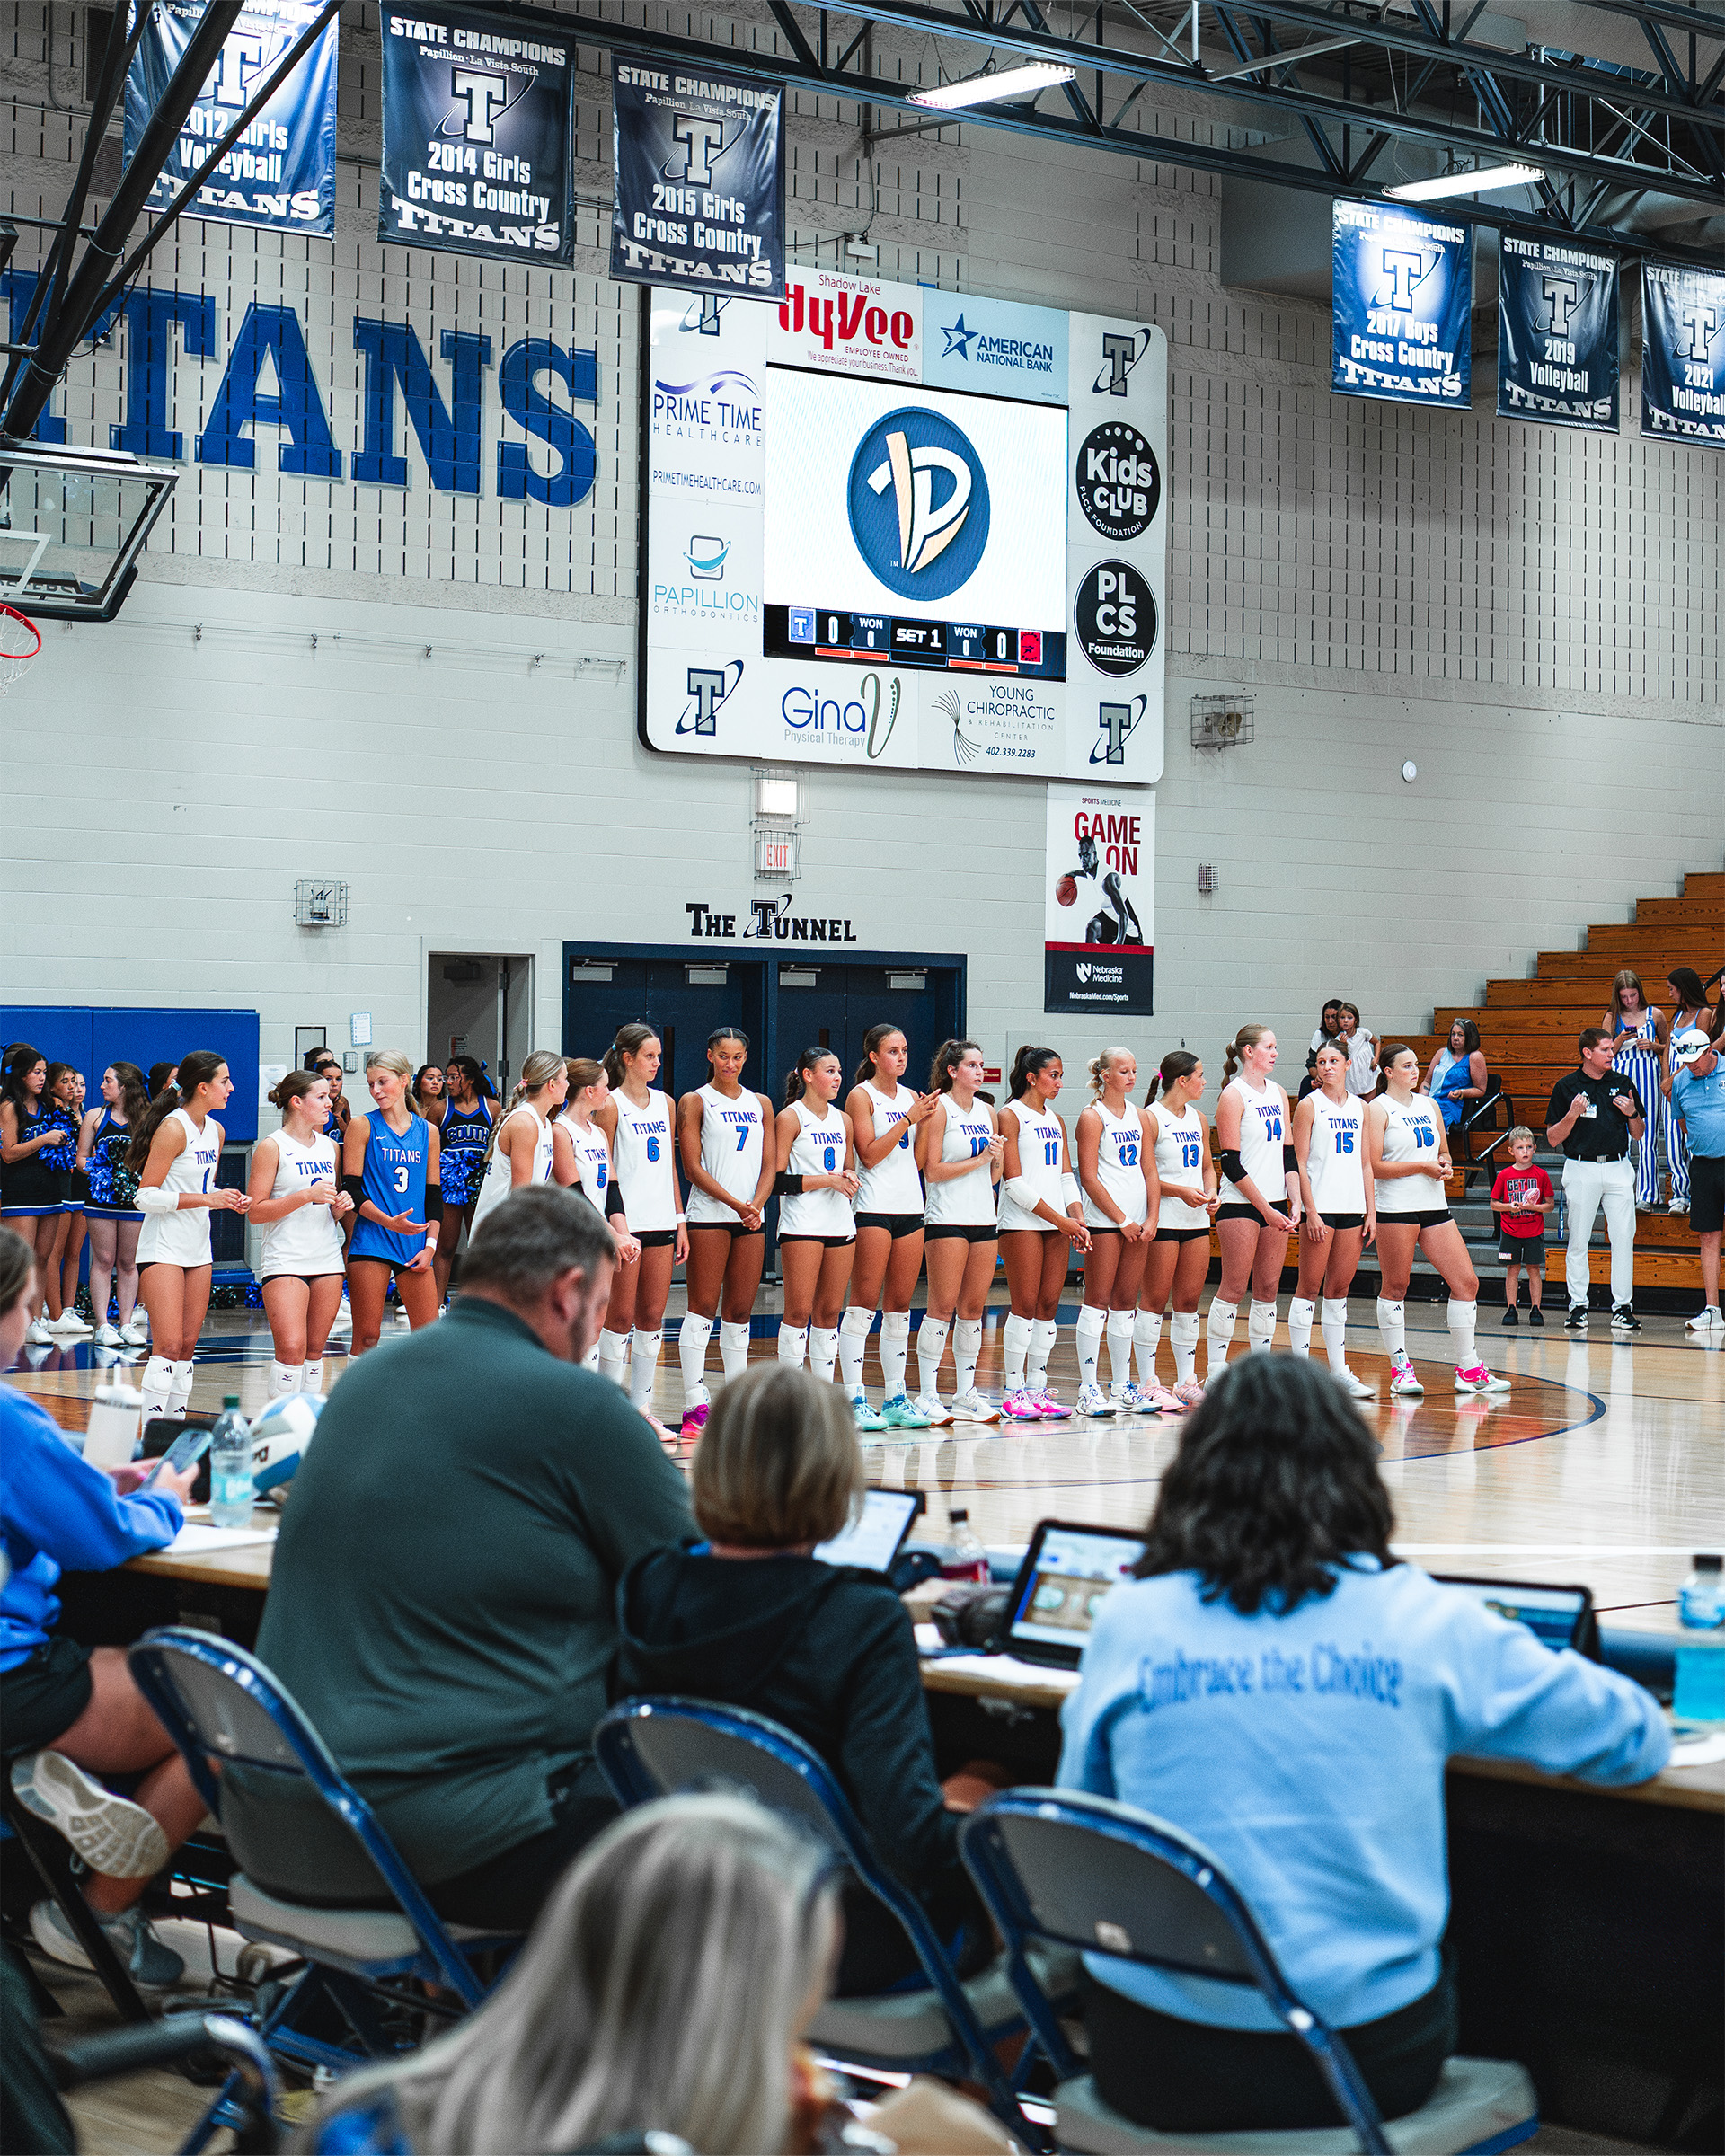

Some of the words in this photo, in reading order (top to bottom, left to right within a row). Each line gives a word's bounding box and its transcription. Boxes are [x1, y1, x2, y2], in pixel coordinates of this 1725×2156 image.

[390, 16, 447, 44] STATE
[453, 29, 566, 66] CHAMPIONS
[419, 45, 465, 64] Papillion
[469, 55, 483, 66] La
[484, 57, 510, 71] Vista
[510, 63, 540, 77] South
[618, 65, 669, 91] STATE
[675, 75, 778, 110] CHAMPIONS
[451, 65, 509, 148] T
[645, 93, 686, 110] Papillion
[688, 101, 702, 112] La
[703, 102, 724, 117] Vista
[724, 109, 753, 122] South
[180, 137, 282, 183] Voleyball
[427, 141, 478, 176] 2014
[483, 151, 531, 184] Girls
[673, 111, 724, 190] T
[407, 170, 467, 207] Cross
[473, 181, 550, 224] Country
[652, 183, 696, 216] 2015
[702, 191, 746, 225] Girls
[391, 194, 561, 252] TITANS
[1339, 210, 1380, 229] STATE
[1383, 216, 1464, 244] CHAMPIONS
[633, 212, 687, 246] Cross
[694, 221, 762, 261] Country
[620, 234, 773, 287] TITANS
[1503, 237, 1540, 258] STATE
[1543, 244, 1614, 273] CHAMPIONS
[1522, 259, 1552, 274] Papillion
[818, 274, 856, 291] Shadow
[859, 280, 881, 296] Lake
[1382, 248, 1422, 314] T
[1646, 266, 1680, 285] STATE
[1542, 274, 1577, 340] T
[1367, 310, 1401, 338] 2017
[1404, 316, 1438, 345] Boys
[1683, 302, 1716, 364] T
[845, 346, 880, 358] EMPLOYEE
[883, 351, 909, 362] OWNED
[977, 335, 1053, 361] AMERICAN
[1350, 334, 1394, 363] Cross
[1398, 341, 1454, 376] Country
[1544, 338, 1576, 365] 2019
[807, 350, 817, 360] We
[818, 353, 848, 367] appreciate
[848, 357, 862, 368] your
[862, 358, 888, 372] business.
[889, 362, 906, 375] Thank
[906, 367, 918, 376] you.
[977, 352, 1025, 369] NATIONAL
[1026, 358, 1053, 373] BANK
[1102, 332, 1136, 397] T
[1339, 355, 1462, 397] TITANS
[1529, 361, 1588, 393] Volleyball
[1684, 364, 1714, 389] 2021
[1505, 377, 1612, 420] TITANS
[653, 393, 711, 425] PRIME
[717, 402, 762, 431] TIME
[1648, 402, 1725, 440] TITAN
[653, 422, 762, 447] HEALTHCARE
[1086, 446, 1153, 488] Kids
[652, 470, 762, 495] PRIMETIMEHEALTHCARE.COM
[1079, 485, 1092, 513] PLCS
[1091, 514, 1143, 537] FOUNDATION
[1093, 486, 1147, 517] CLUB
[654, 584, 758, 613] PAPILLION
[1098, 570, 1136, 605] PL
[654, 605, 758, 623] ORTHODONTICS
[859, 617, 883, 630] WON
[1096, 603, 1137, 637] CS
[828, 615, 838, 644] 0
[867, 630, 875, 648] 0
[896, 628, 927, 644] SET
[930, 630, 942, 648] 1
[954, 626, 978, 639] WON
[962, 639, 970, 657] 0
[997, 632, 1007, 659] 0
[1088, 642, 1145, 659] Foundation
[687, 667, 725, 737] T
[989, 685, 1034, 701] YOUNG
[782, 686, 866, 733] Gina
[966, 701, 1056, 720] CHIROPRACTIC
[978, 719, 1054, 731] REHABILITATION
[994, 732, 1029, 741] CENTER
[1100, 700, 1135, 764] T
[784, 729, 824, 745] Physical
[826, 732, 865, 749] Therapy
[986, 747, 1036, 759] 402.339.2283
[1082, 797, 1100, 805] SPORTS
[1100, 799, 1121, 807] MEDICINE
[1075, 811, 1141, 845] GAME
[766, 844, 788, 867] EXIT
[1106, 845, 1137, 876] ON
[1092, 965, 1123, 975] Nebraska
[1092, 974, 1123, 983] Medicine
[1069, 991, 1129, 1003] NebraskaMed.com/Sports
[720, 1111, 757, 1123] TITANS
[885, 1111, 907, 1123] TITA
[1255, 1105, 1282, 1118] TITANS
[1328, 1118, 1358, 1130] TITANS
[1402, 1115, 1432, 1127] TITANS
[447, 1124, 490, 1144] SOUTH
[632, 1121, 667, 1135] TITANS
[735, 1125, 749, 1151] 7
[810, 1132, 844, 1144] TITANS
[959, 1124, 990, 1135] TITANS
[1034, 1127, 1062, 1139] TITANS
[1111, 1129, 1140, 1144] TITANS
[1172, 1131, 1201, 1144] TITANS
[1265, 1118, 1282, 1142] 14
[1413, 1126, 1435, 1148] 16
[647, 1136, 659, 1162] 6
[1044, 1142, 1057, 1166] 11
[1119, 1144, 1137, 1166] 12
[1335, 1132, 1354, 1153] 15
[194, 1149, 217, 1165] TITANS
[296, 1161, 333, 1175] TITANS
[382, 1147, 421, 1164] TITANS
[823, 1146, 836, 1171] 8
[1182, 1144, 1199, 1168] 13
[394, 1166, 409, 1193] 3
[597, 1163, 606, 1189] 5
[1506, 1178, 1526, 1192] GET
